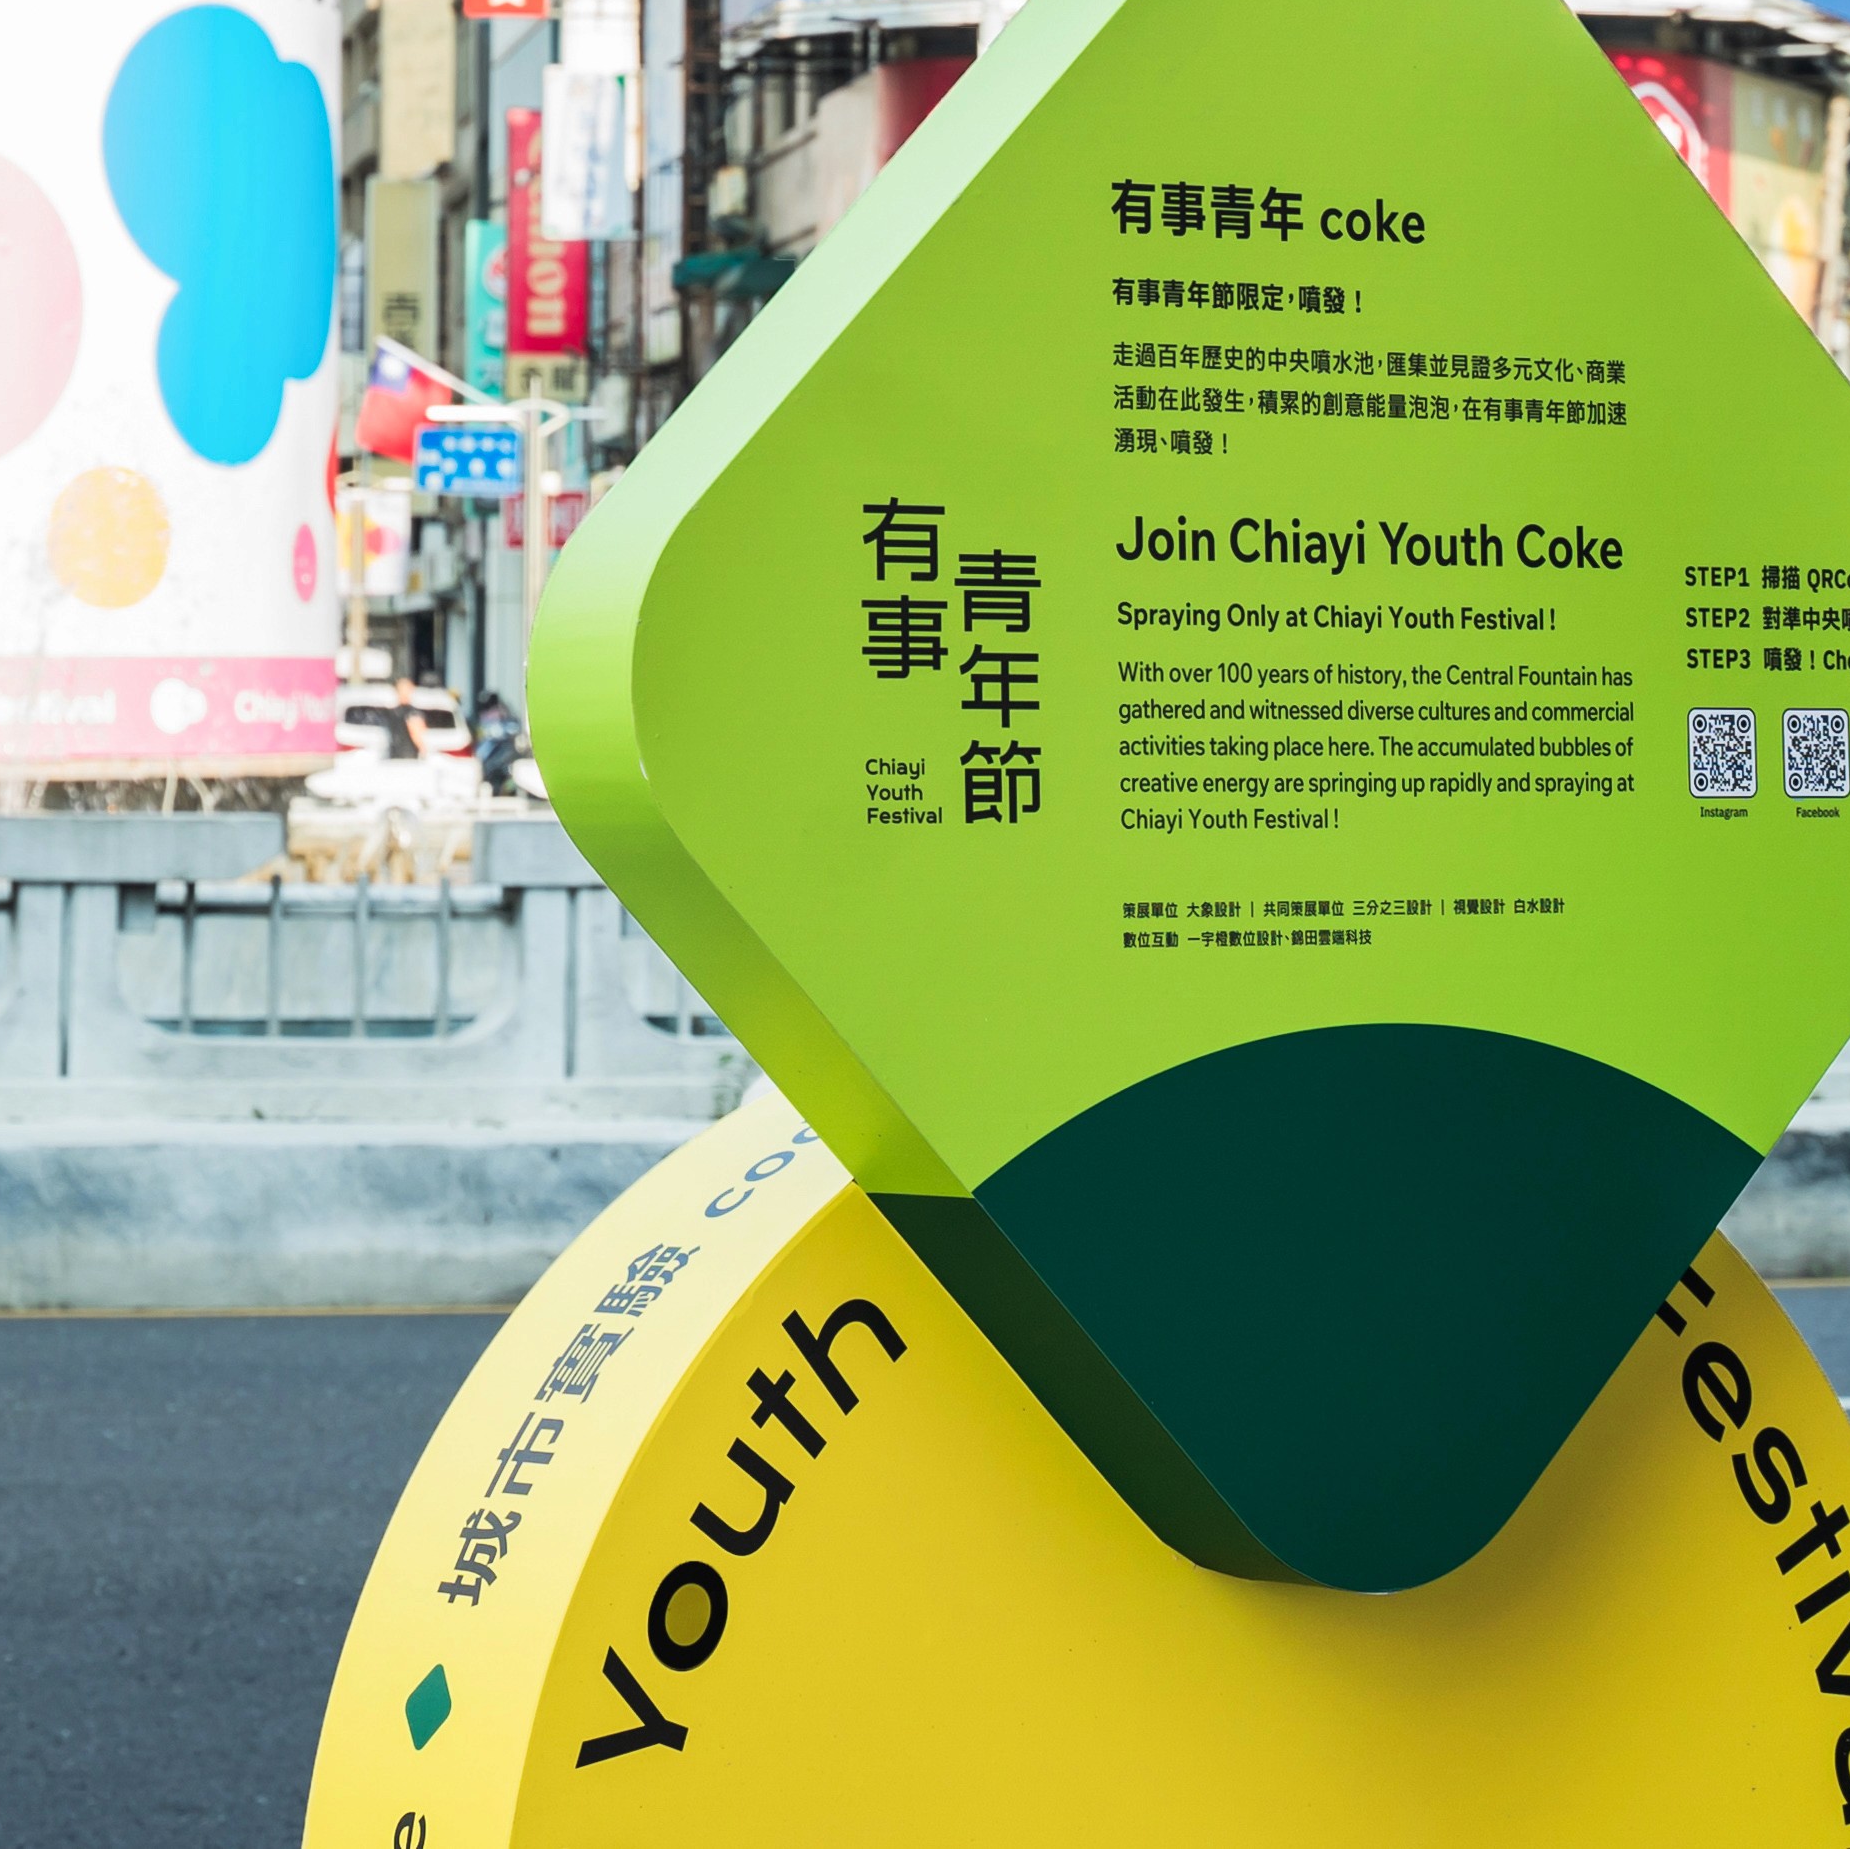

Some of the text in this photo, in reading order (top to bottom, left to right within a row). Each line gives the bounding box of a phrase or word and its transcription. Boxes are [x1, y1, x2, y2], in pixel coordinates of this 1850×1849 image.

[1110, 178, 1426, 245] 有事青年 coke
[1115, 514, 1623, 576] Join Chiayi Youth Coke
[1684, 565, 1751, 588] STEP1
[1761, 564, 1801, 591] 掃描
[1117, 601, 1221, 633] Spraying
[1226, 602, 1280, 633] Only
[1285, 606, 1308, 628] at
[1313, 604, 1383, 634] Chiayi
[1388, 605, 1455, 630] Youth
[1460, 606, 1544, 631] Festival
[1685, 606, 1751, 629] STEP2
[1686, 647, 1751, 670] STEP3
[1763, 646, 1816, 672] 噴發！
[1117, 660, 1633, 690] With over 100 years of history, the Central Fountain has
[1118, 698, 1634, 725] gathered and witnessed diverse cultures and commercial
[1118, 734, 1634, 762] activities taking place here. The accumulated bubbles of
[865, 757, 926, 781] Chiayi
[866, 783, 924, 801] Youth
[1119, 771, 1635, 798] creative energy are springing up rapidly and spraying at
[867, 806, 943, 825] Festival
[1120, 807, 1183, 835] Chiayi
[1188, 808, 1248, 830] Youth
[1253, 807, 1329, 830] Festival
[1700, 806, 1749, 821] Instagram
[1796, 806, 1840, 818] Facebook
[437, 1242, 701, 1607] 城市實驗
[575, 1298, 909, 1769] Youth
